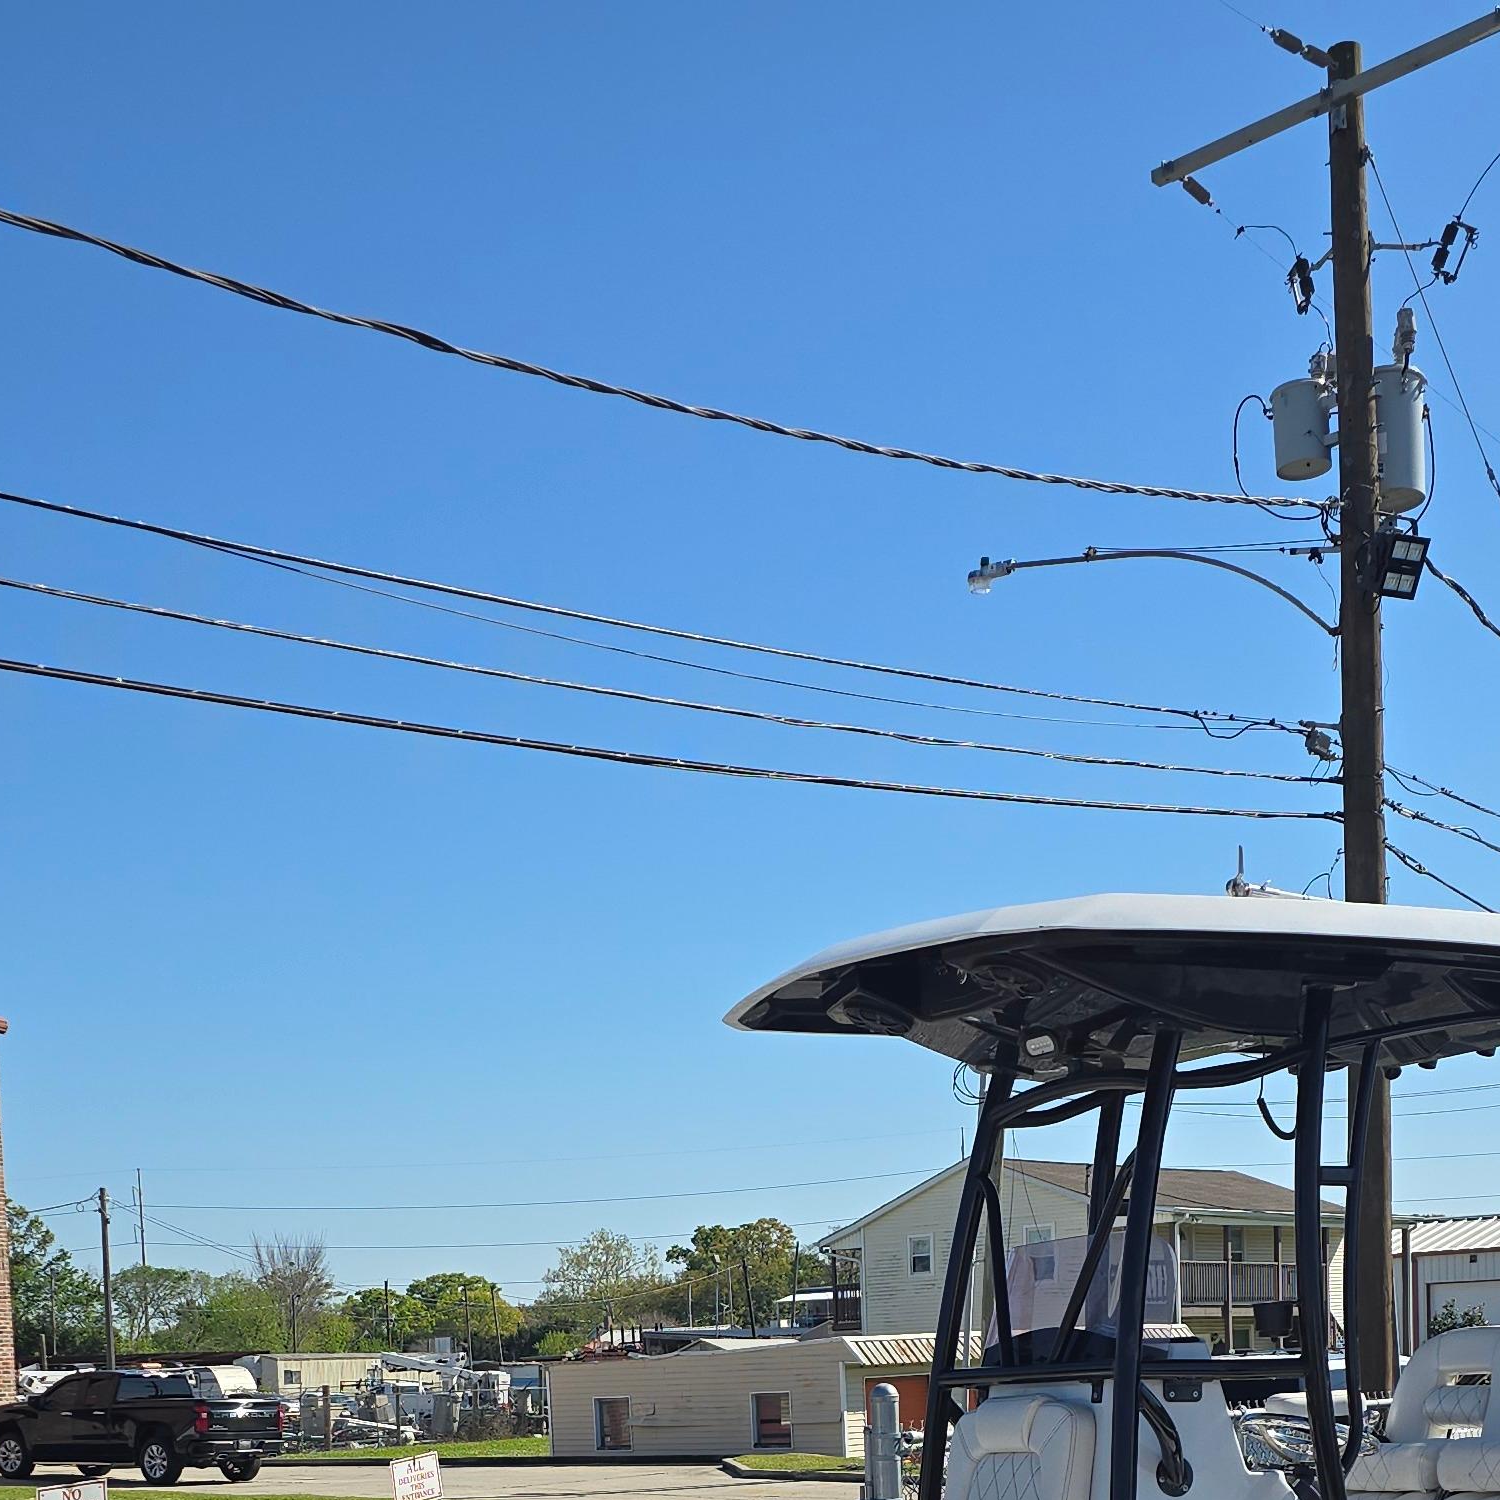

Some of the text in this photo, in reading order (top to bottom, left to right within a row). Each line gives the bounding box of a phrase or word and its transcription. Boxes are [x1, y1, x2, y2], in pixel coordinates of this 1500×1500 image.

[407, 1461, 424, 1474] ALL
[399, 1471, 434, 1485] DELIVERIES
[410, 1482, 425, 1491] THIS
